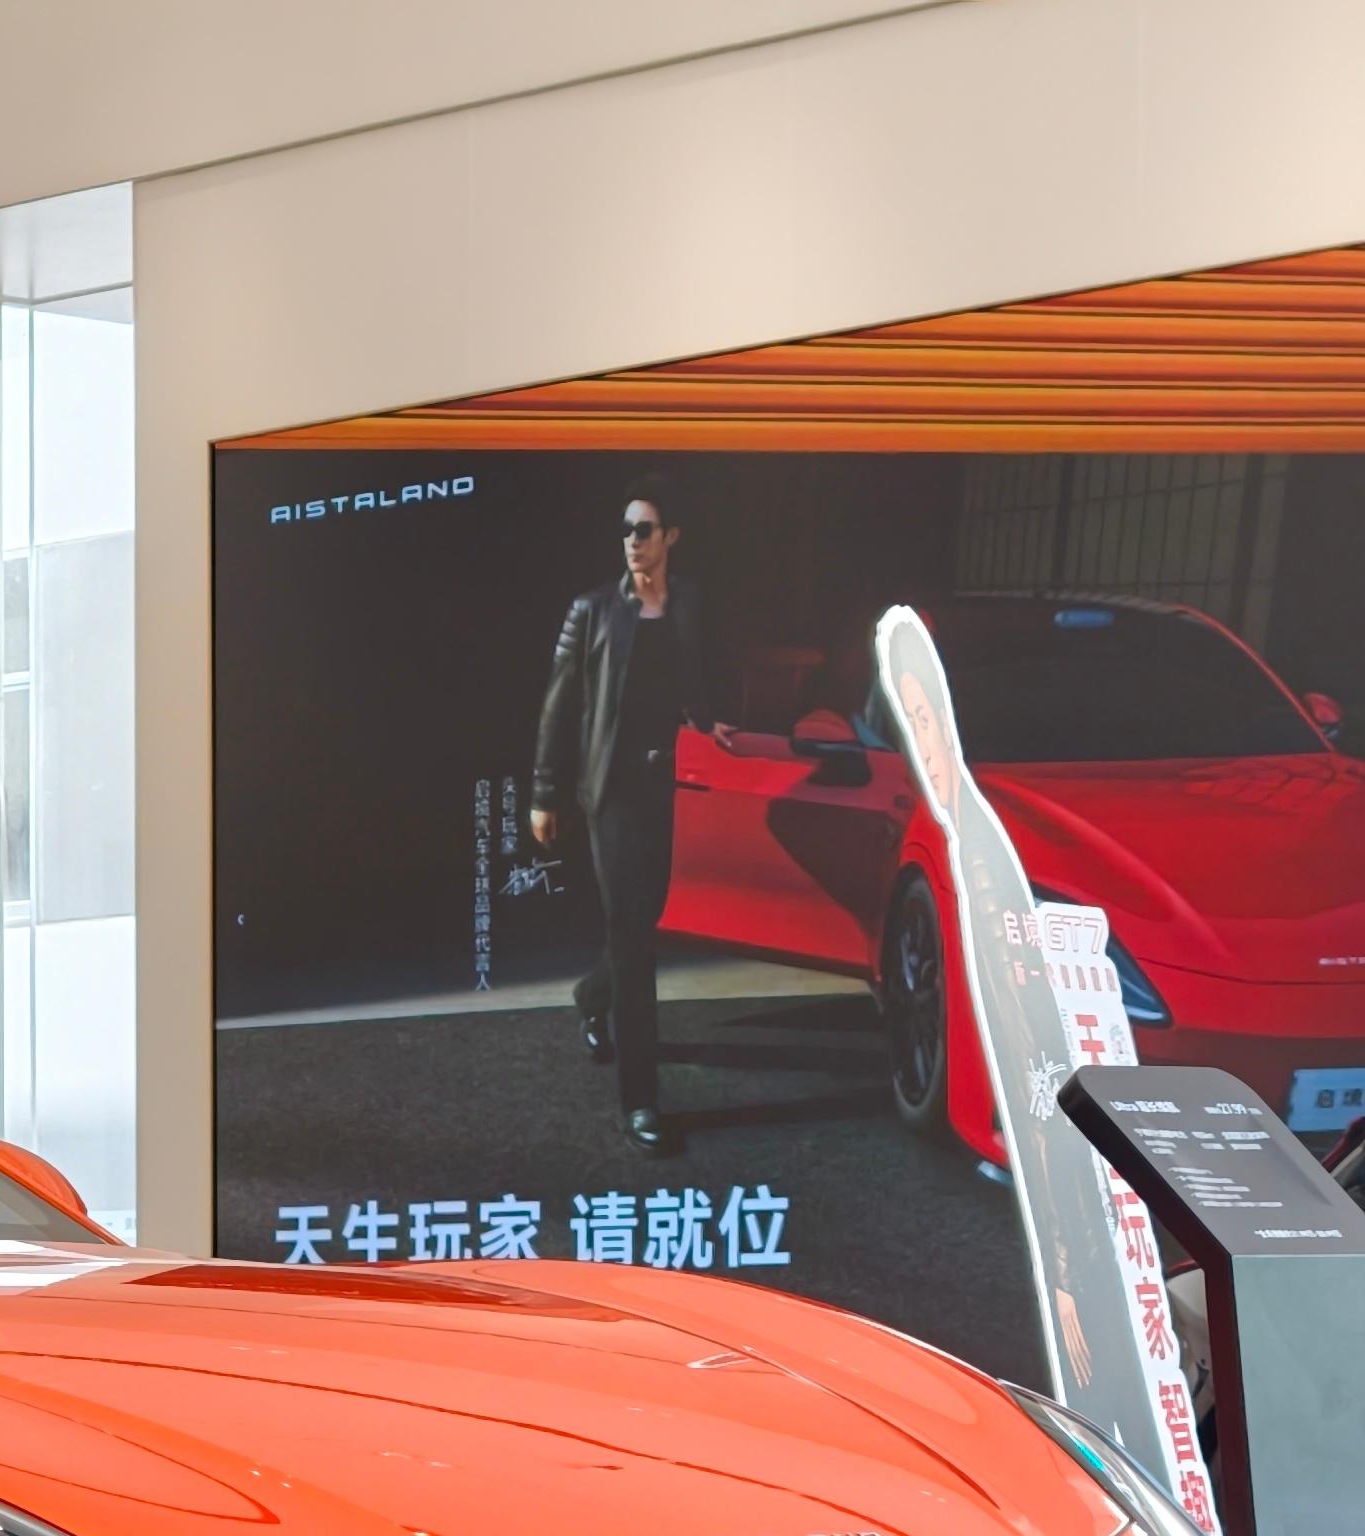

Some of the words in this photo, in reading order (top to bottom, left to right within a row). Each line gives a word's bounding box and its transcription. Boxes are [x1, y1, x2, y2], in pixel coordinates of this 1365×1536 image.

[270, 476, 474, 523] AISTALAND
[1045, 913, 1105, 954] GT7
[275, 1194, 541, 1264] 天生玩家
[569, 1184, 791, 1269] 请就位
